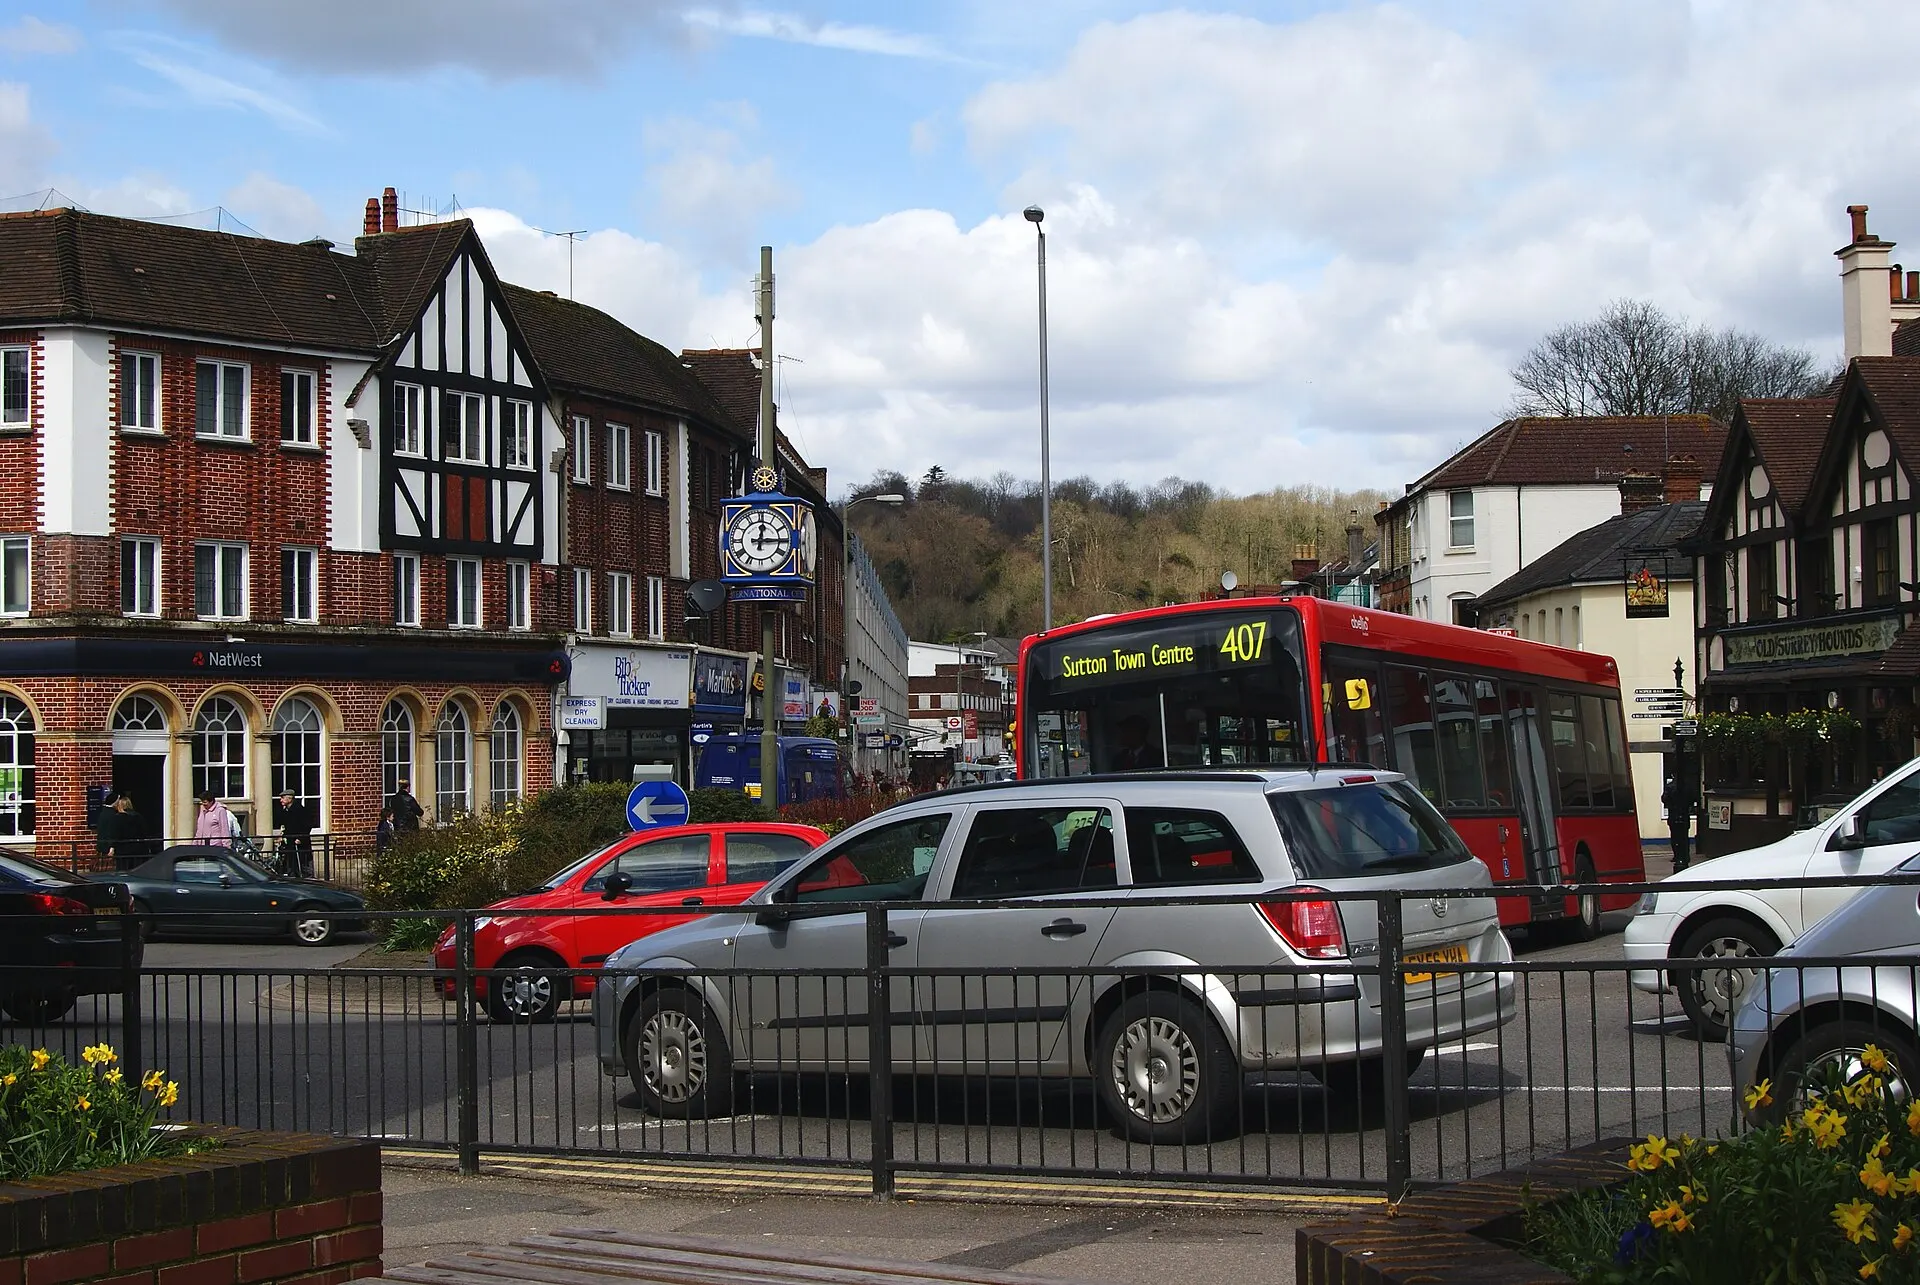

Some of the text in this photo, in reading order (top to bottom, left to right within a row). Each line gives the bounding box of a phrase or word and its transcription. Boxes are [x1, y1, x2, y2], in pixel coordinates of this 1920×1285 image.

[1220, 621, 1266, 662] 407
[1755, 627, 1864, 658] OLD SURREY HOUNDS
[209, 651, 262, 667] NatWest
[615, 657, 631, 676] Bib
[1063, 644, 1194, 678] Sutton Town Centre
[617, 675, 650, 696] Tucker
[707, 669, 735, 695] Martin's
[564, 718, 598, 726] CLEANING
